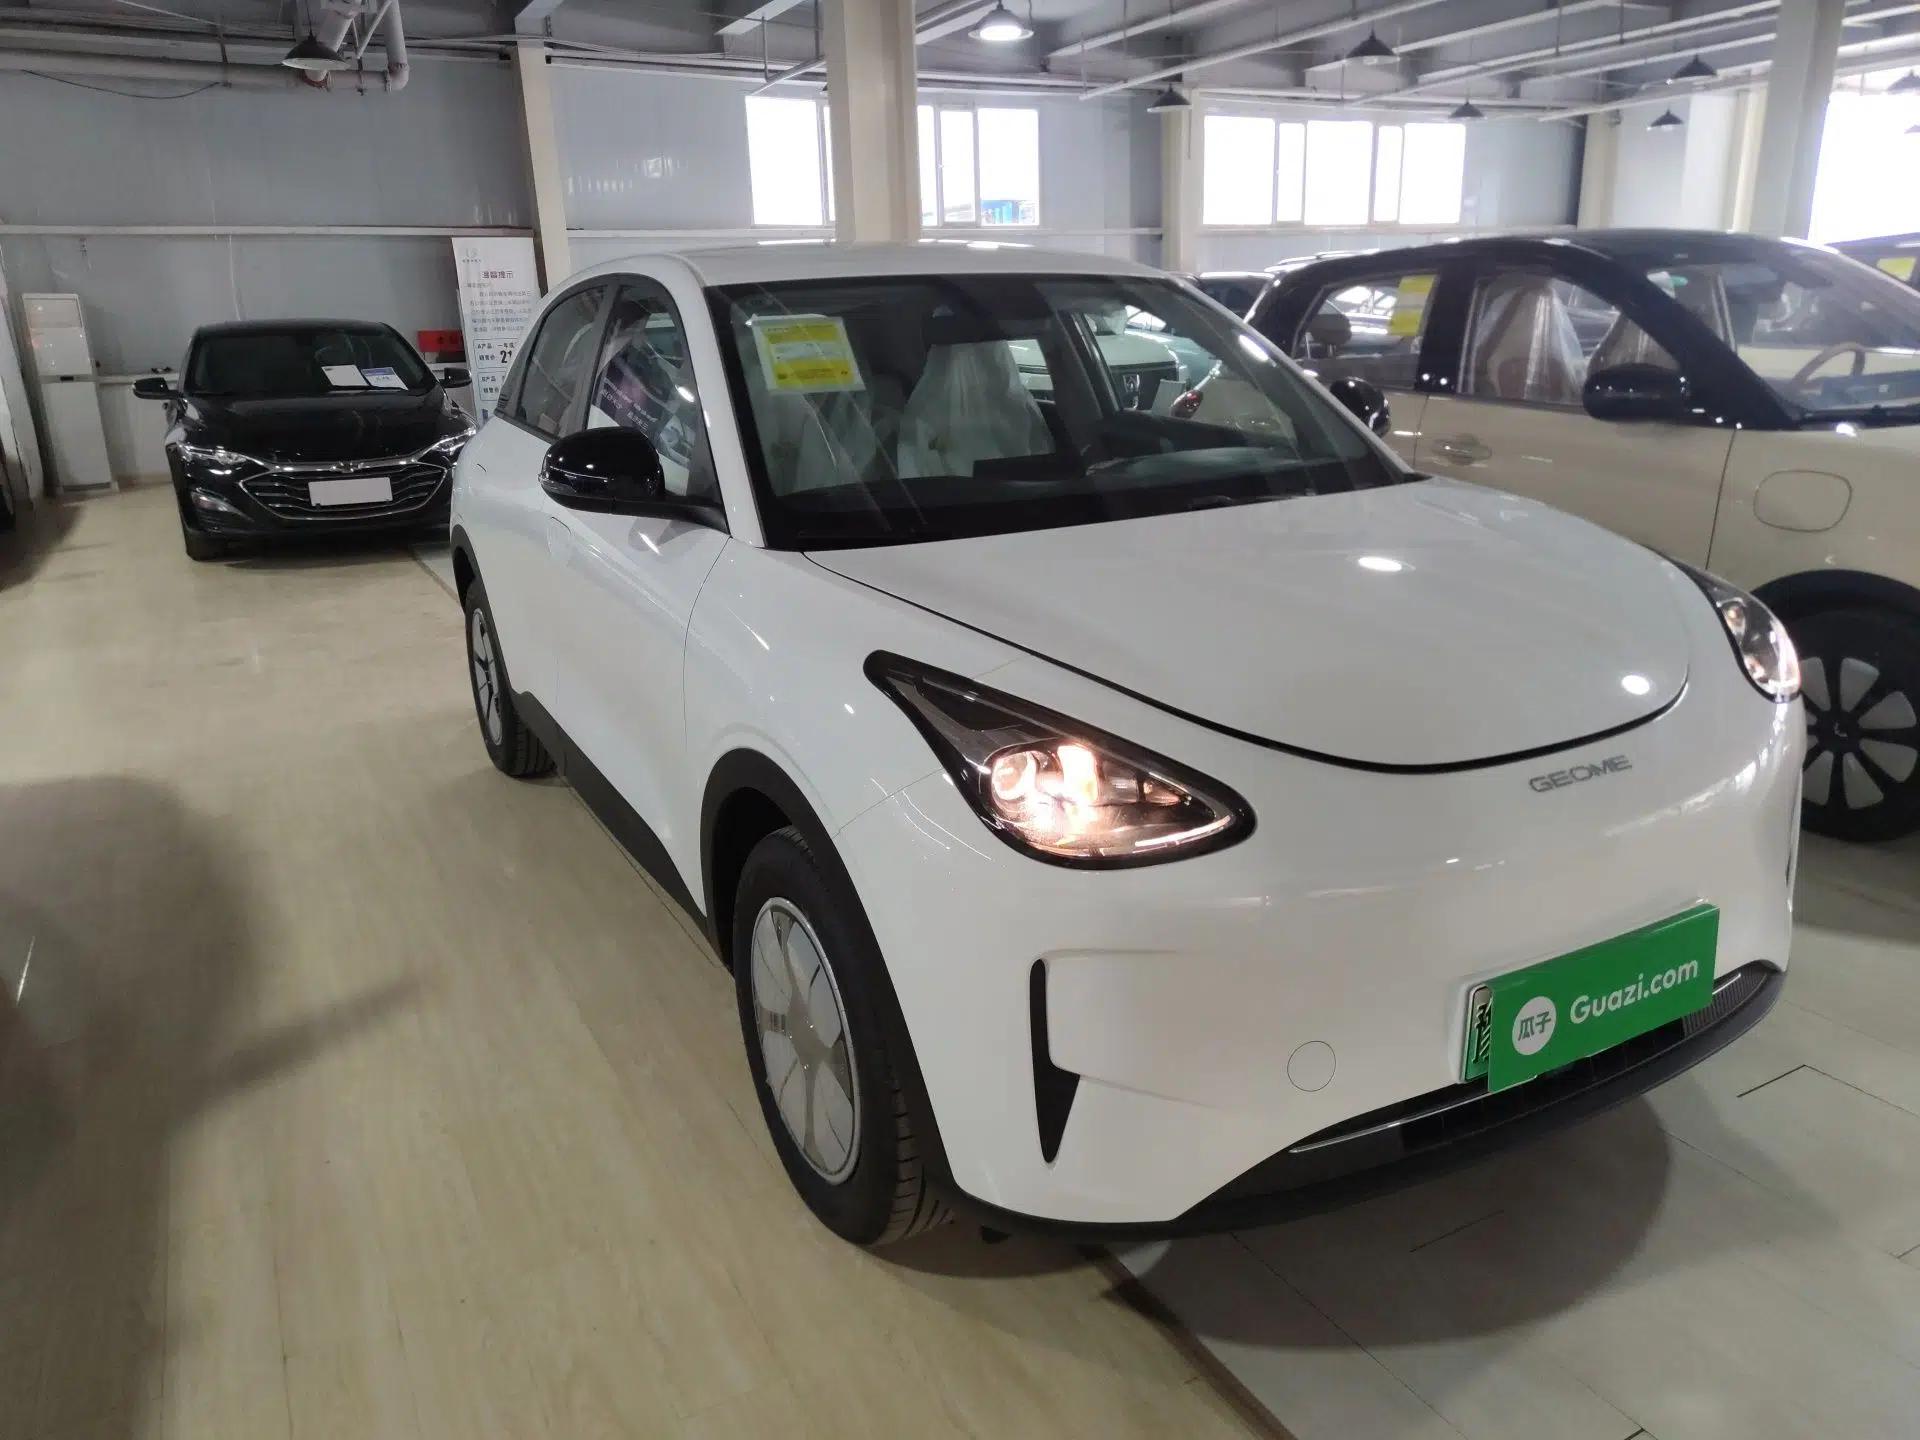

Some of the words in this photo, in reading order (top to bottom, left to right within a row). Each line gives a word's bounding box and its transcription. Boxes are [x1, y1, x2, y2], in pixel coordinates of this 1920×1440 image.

[1529, 755, 1633, 793] GEOME
[1517, 1011, 1552, 1042] 瓜子
[1569, 959, 1698, 1025] Guazi.com
